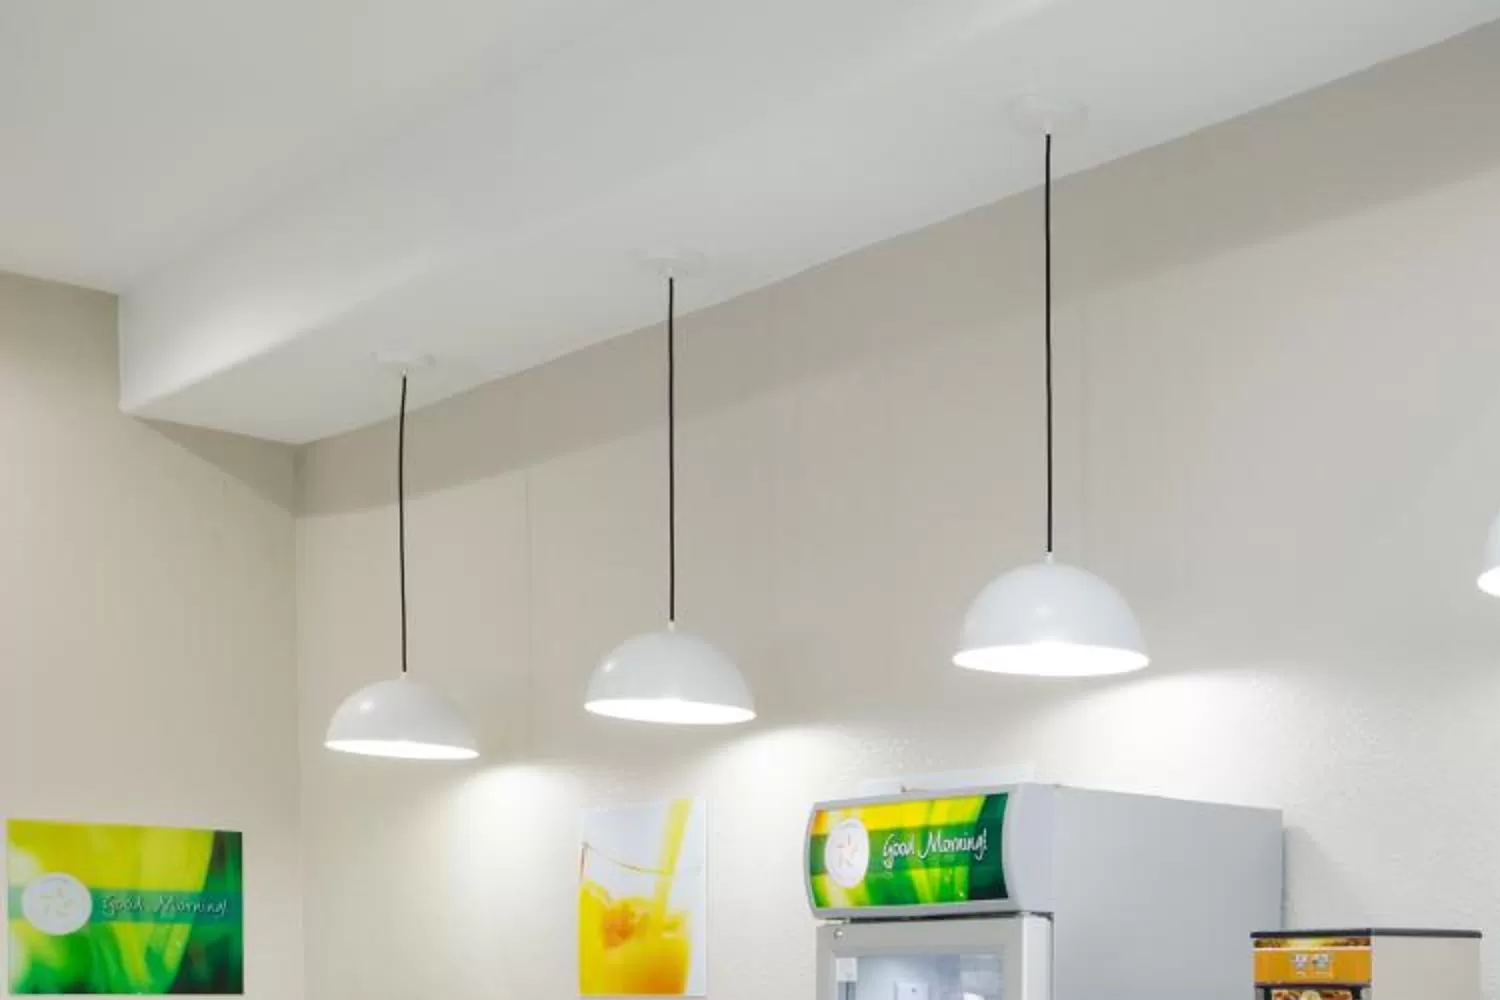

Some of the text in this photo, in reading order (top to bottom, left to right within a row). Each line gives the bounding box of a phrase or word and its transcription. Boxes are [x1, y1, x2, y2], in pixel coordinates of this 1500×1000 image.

[882, 828, 988, 869] Good Morning!
[102, 894, 229, 918] Good Morning!
